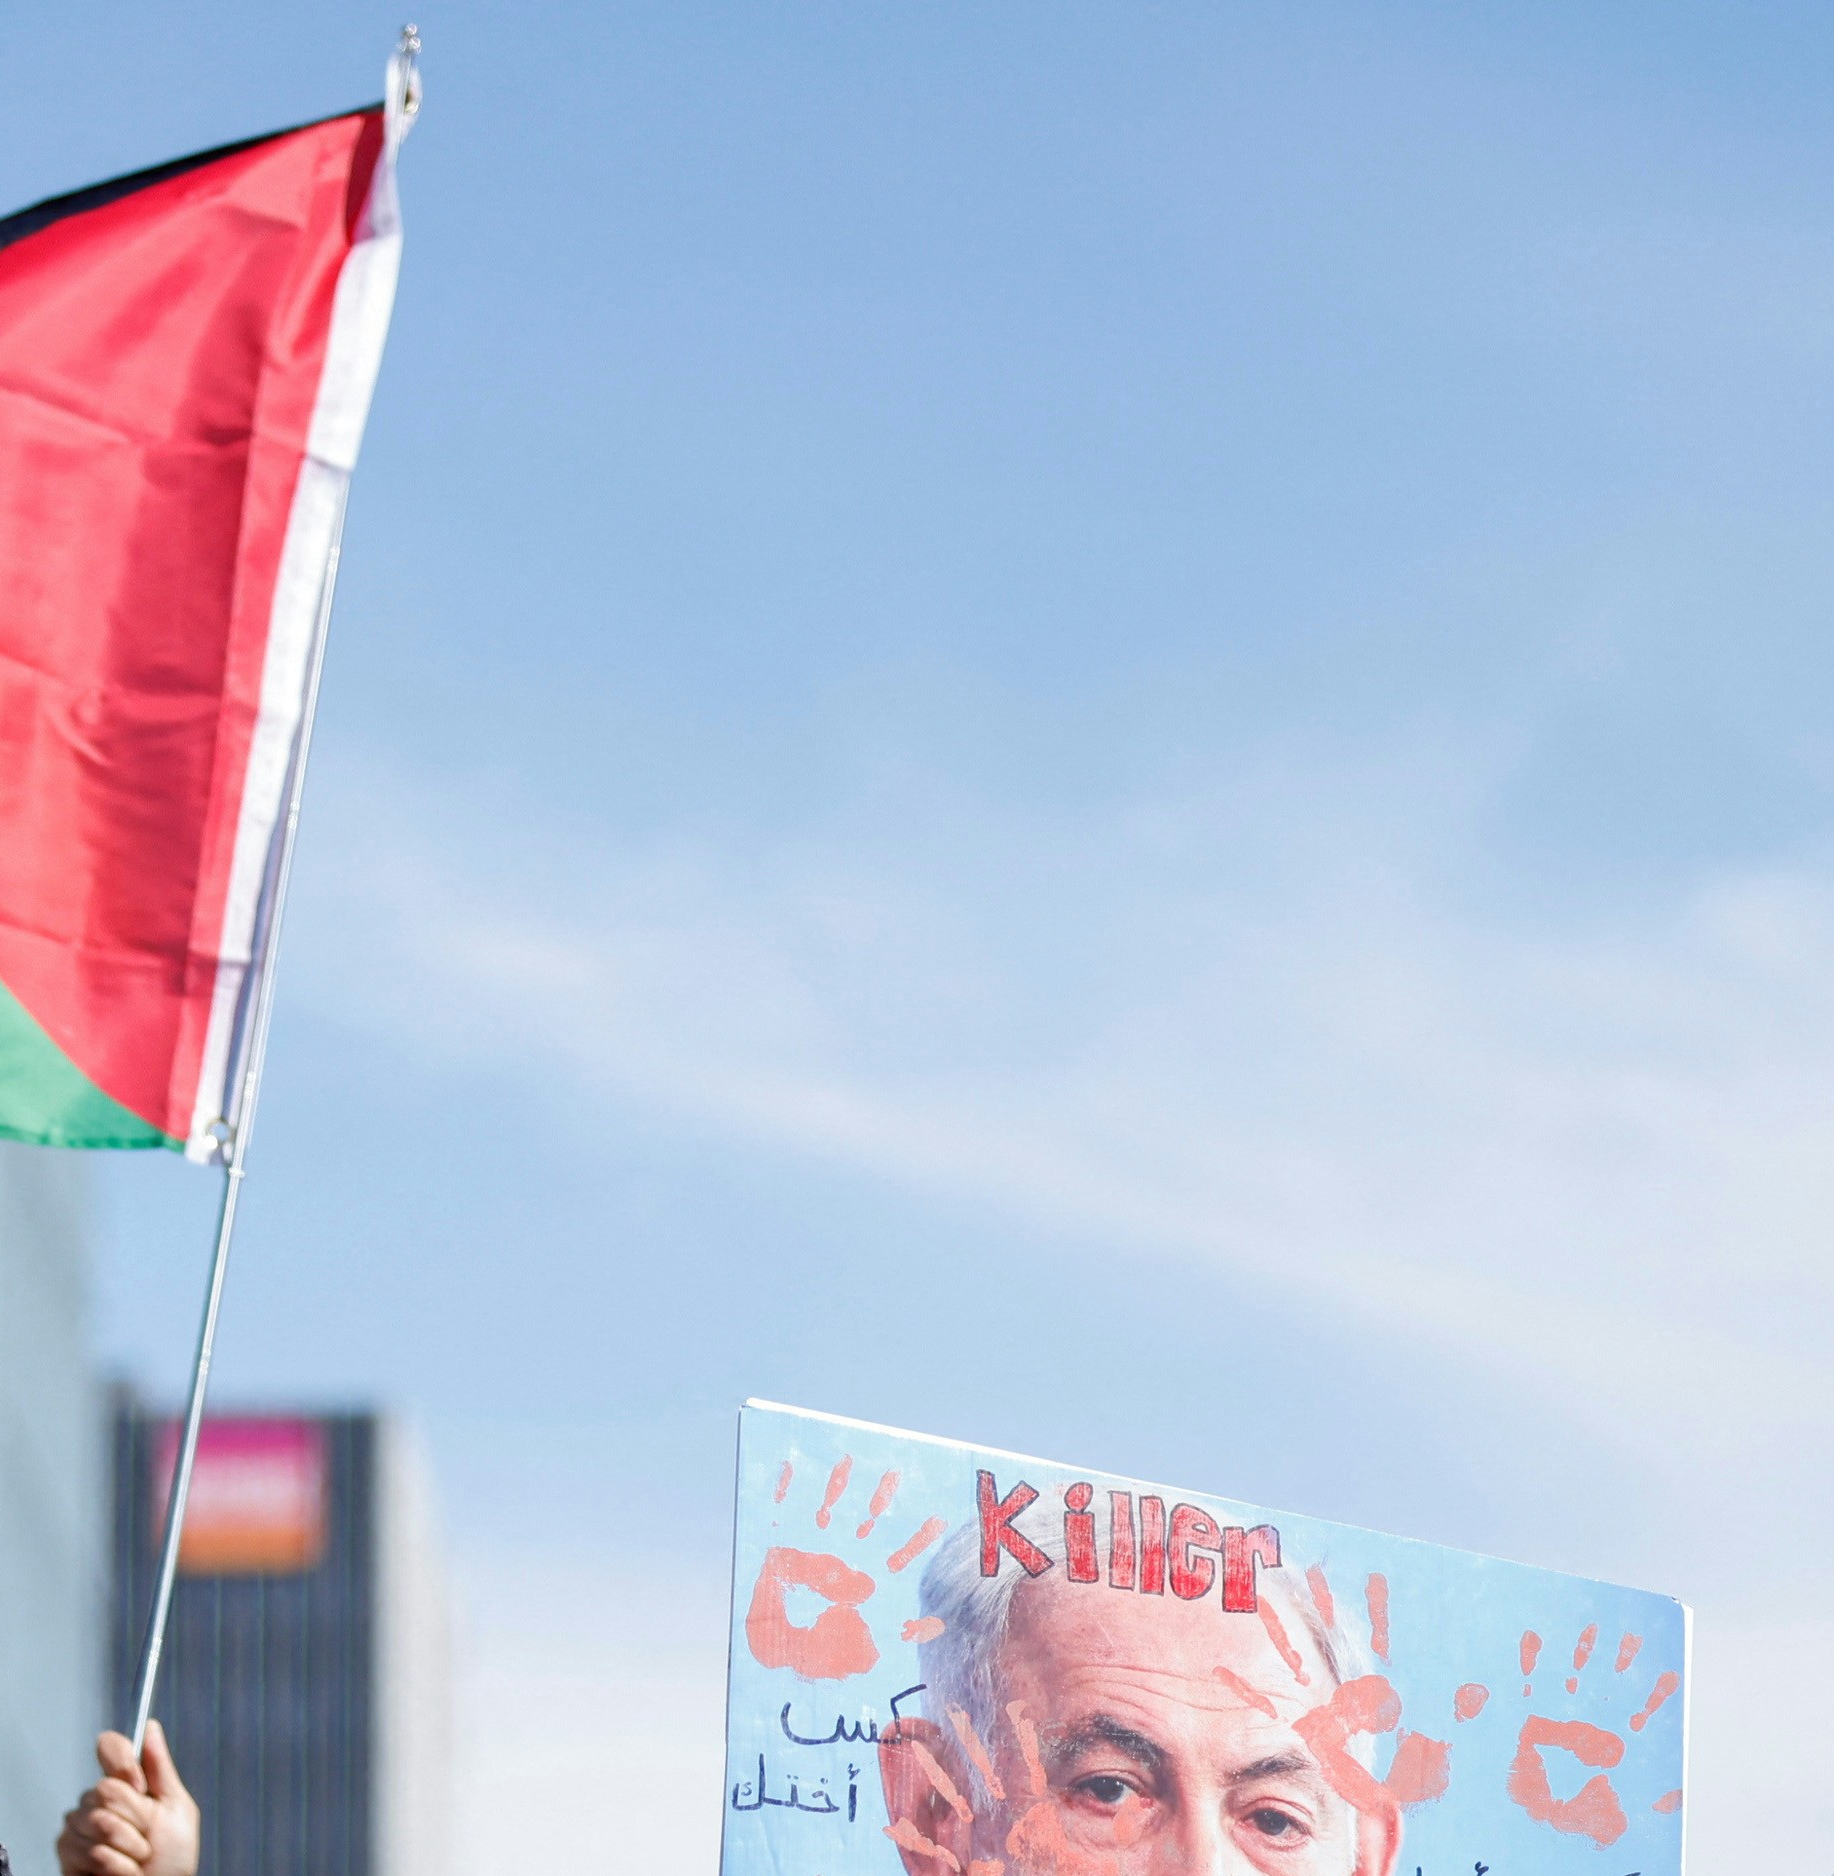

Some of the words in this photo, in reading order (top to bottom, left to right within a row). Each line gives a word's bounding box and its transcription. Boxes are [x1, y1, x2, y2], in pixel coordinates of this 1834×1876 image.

[976, 1468, 1283, 1613] Killer
[779, 1683, 927, 1746] كس
[732, 1752, 861, 1823] أختك
